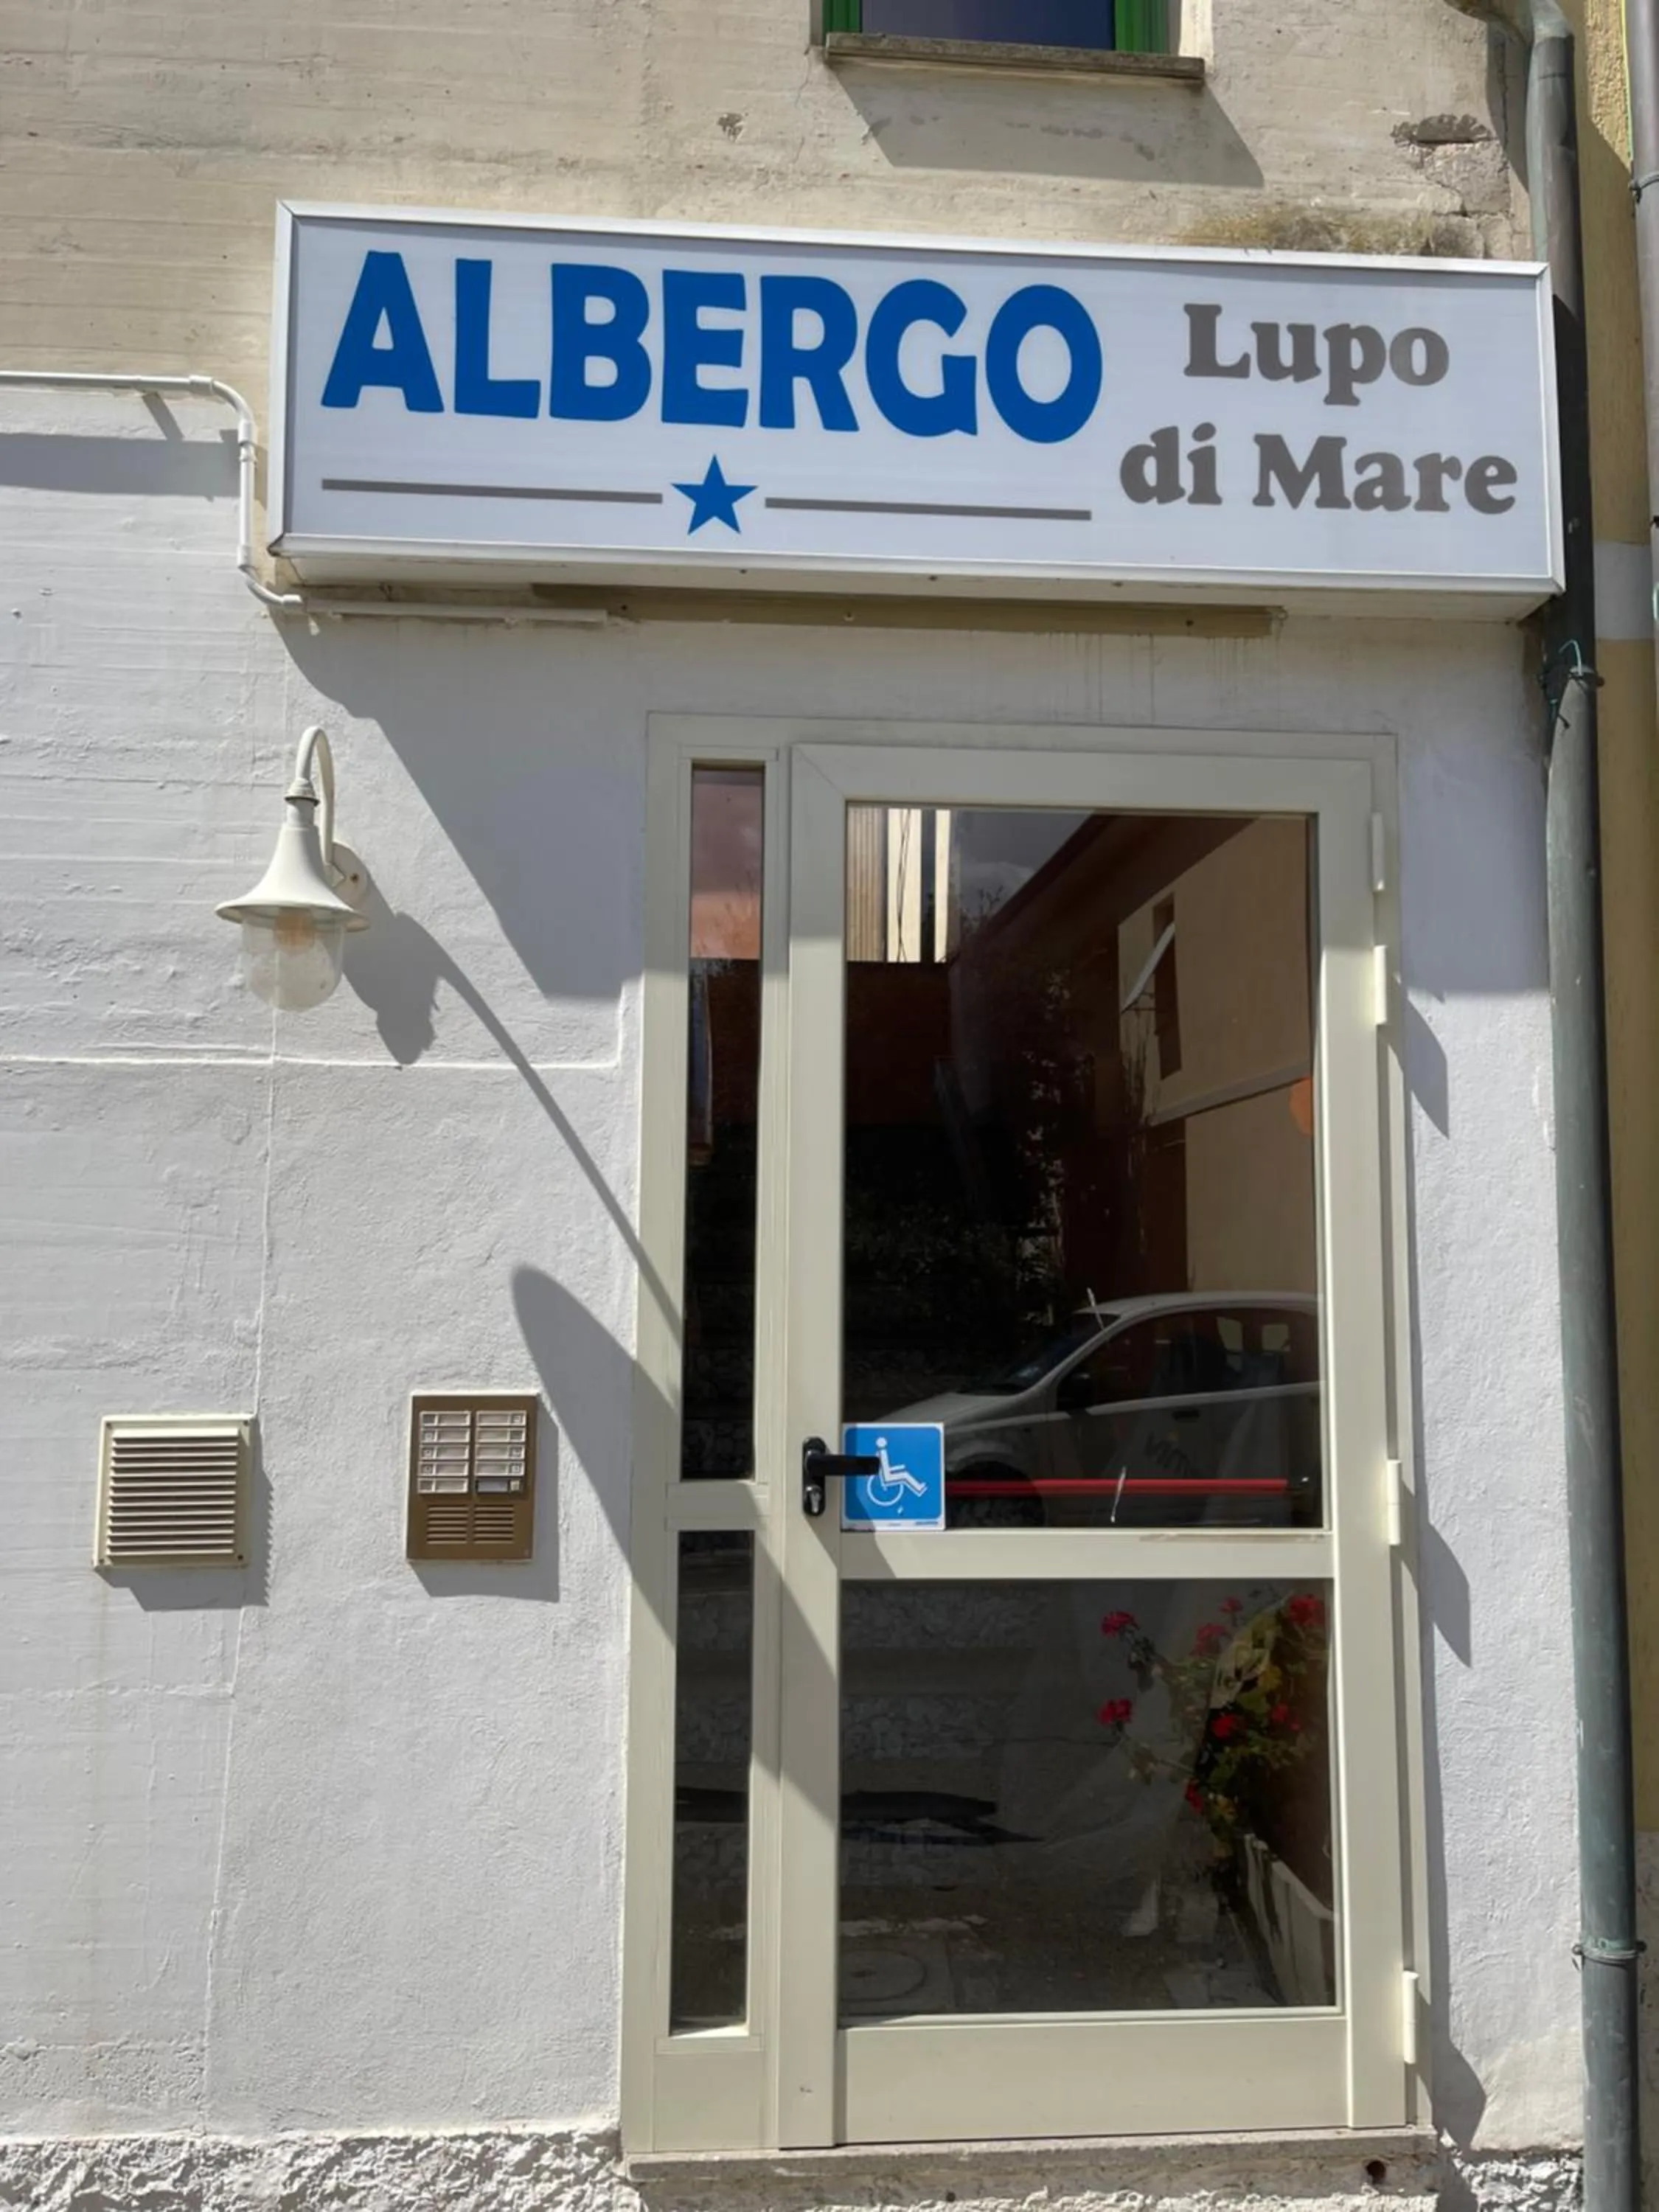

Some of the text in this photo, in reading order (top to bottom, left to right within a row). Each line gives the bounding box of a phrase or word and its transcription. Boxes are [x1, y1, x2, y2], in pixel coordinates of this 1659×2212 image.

[321, 250, 1103, 445] ALBERGO
[1183, 303, 1450, 406] Lupo
[1120, 422, 1518, 515] di Mare
